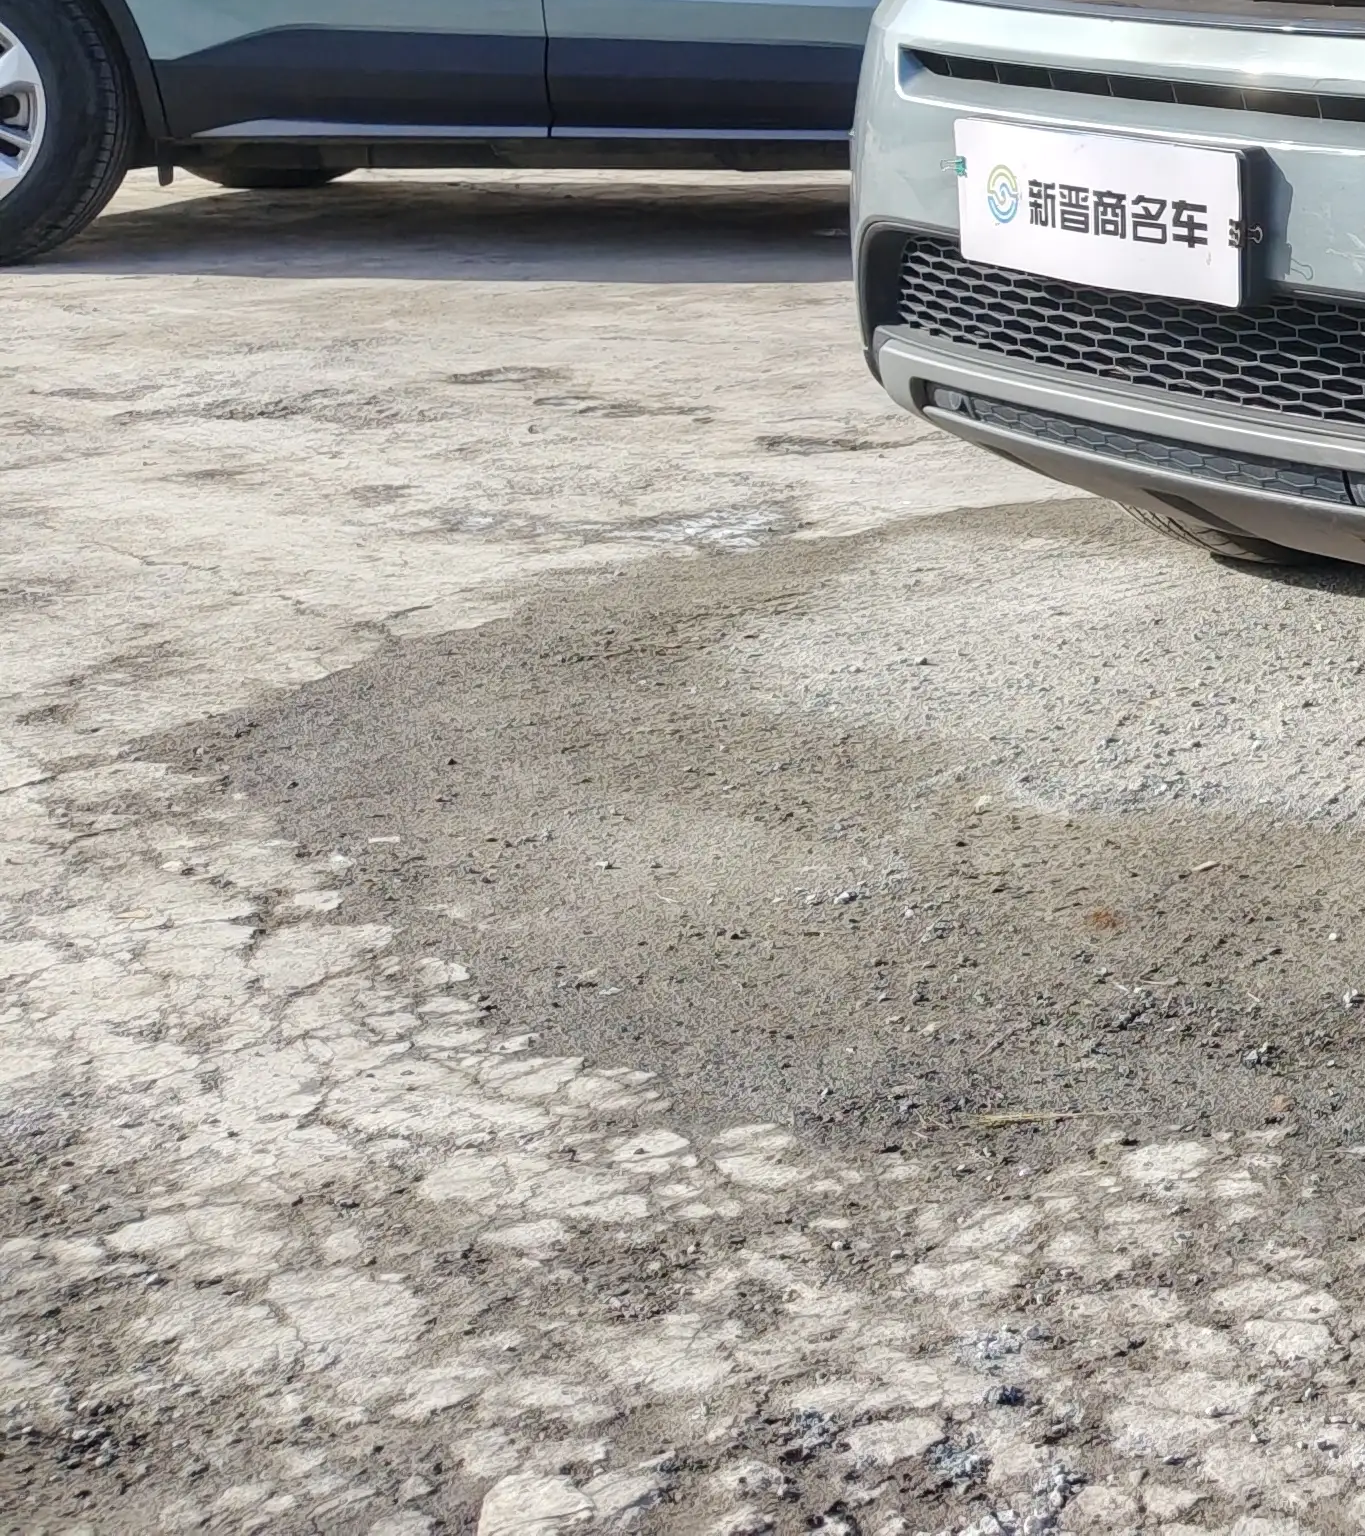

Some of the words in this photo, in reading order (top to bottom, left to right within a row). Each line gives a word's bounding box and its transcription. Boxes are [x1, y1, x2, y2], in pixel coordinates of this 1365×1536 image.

[1028, 178, 1209, 249] 新晋商名车
